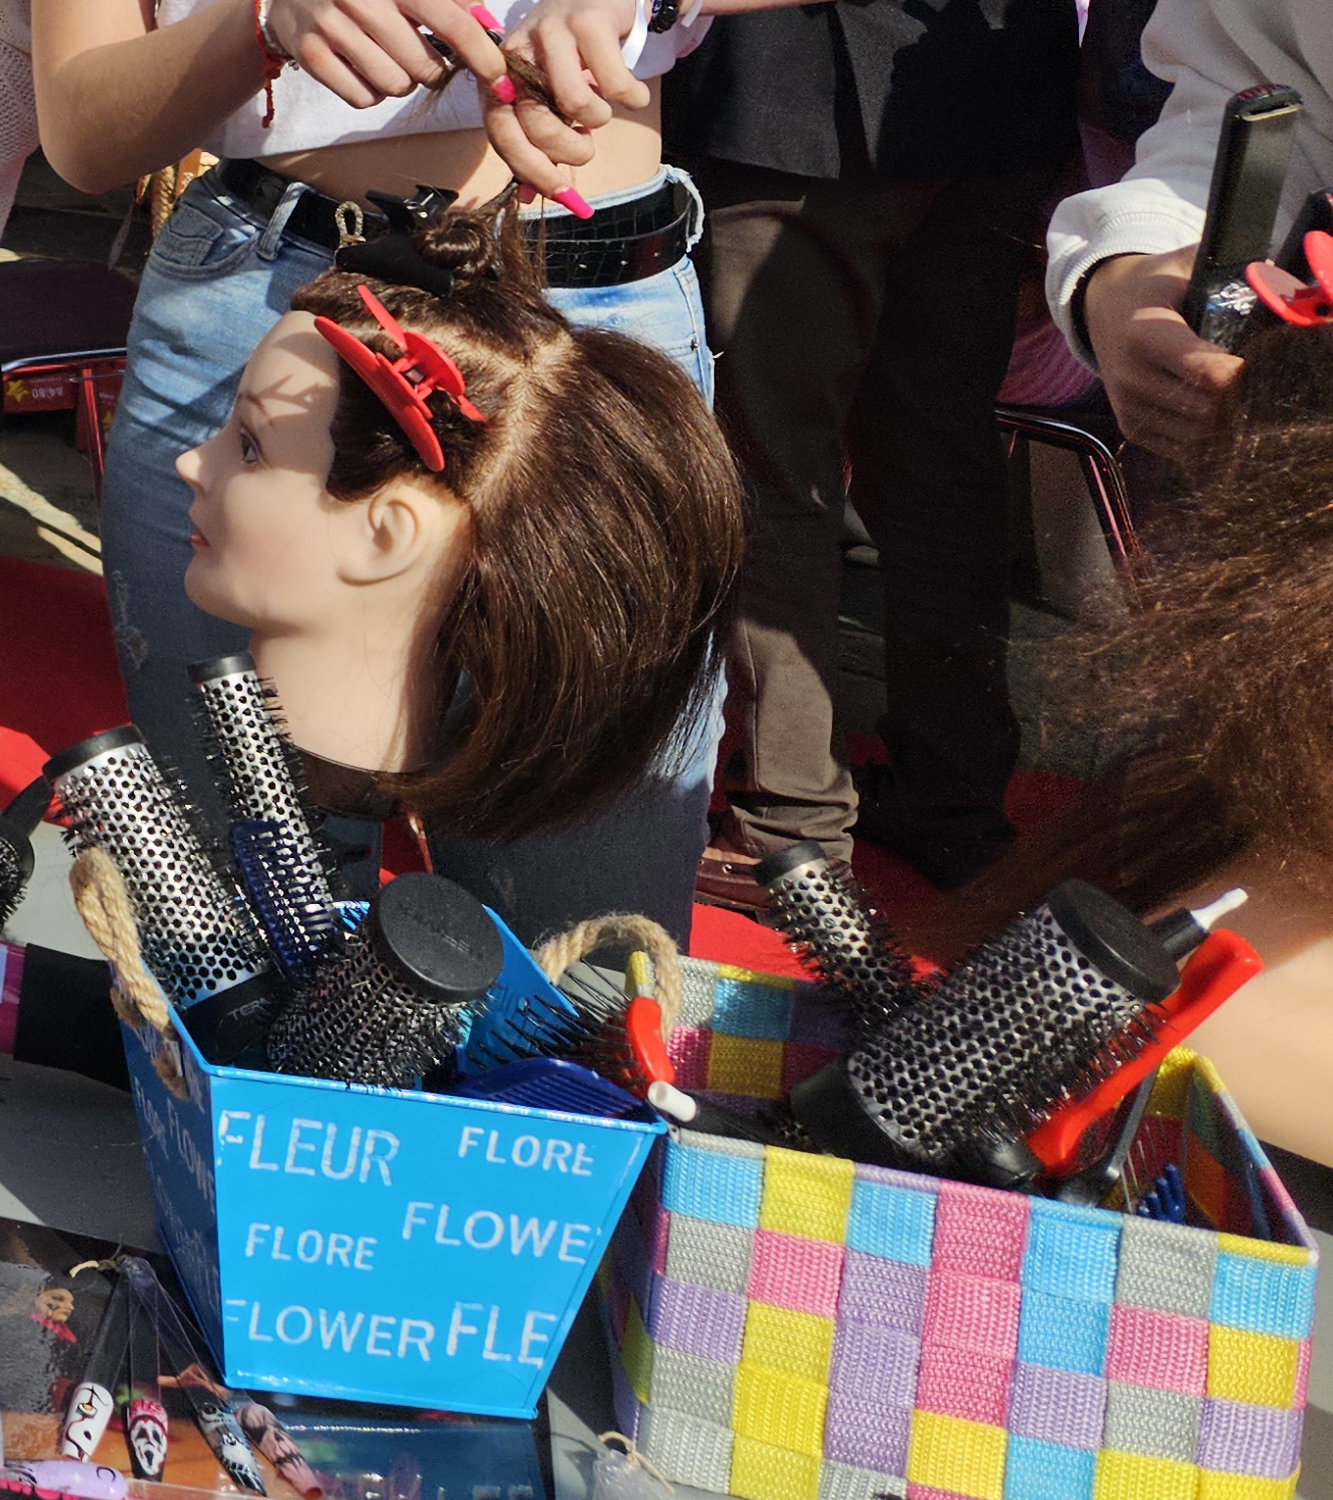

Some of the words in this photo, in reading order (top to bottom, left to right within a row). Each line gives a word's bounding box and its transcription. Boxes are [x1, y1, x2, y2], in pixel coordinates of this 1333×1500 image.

[218, 1109, 401, 1187] FLEUR
[458, 1126, 597, 1177] FLORE
[245, 1223, 379, 1271] FLORE
[445, 1300, 560, 1370] FLE
